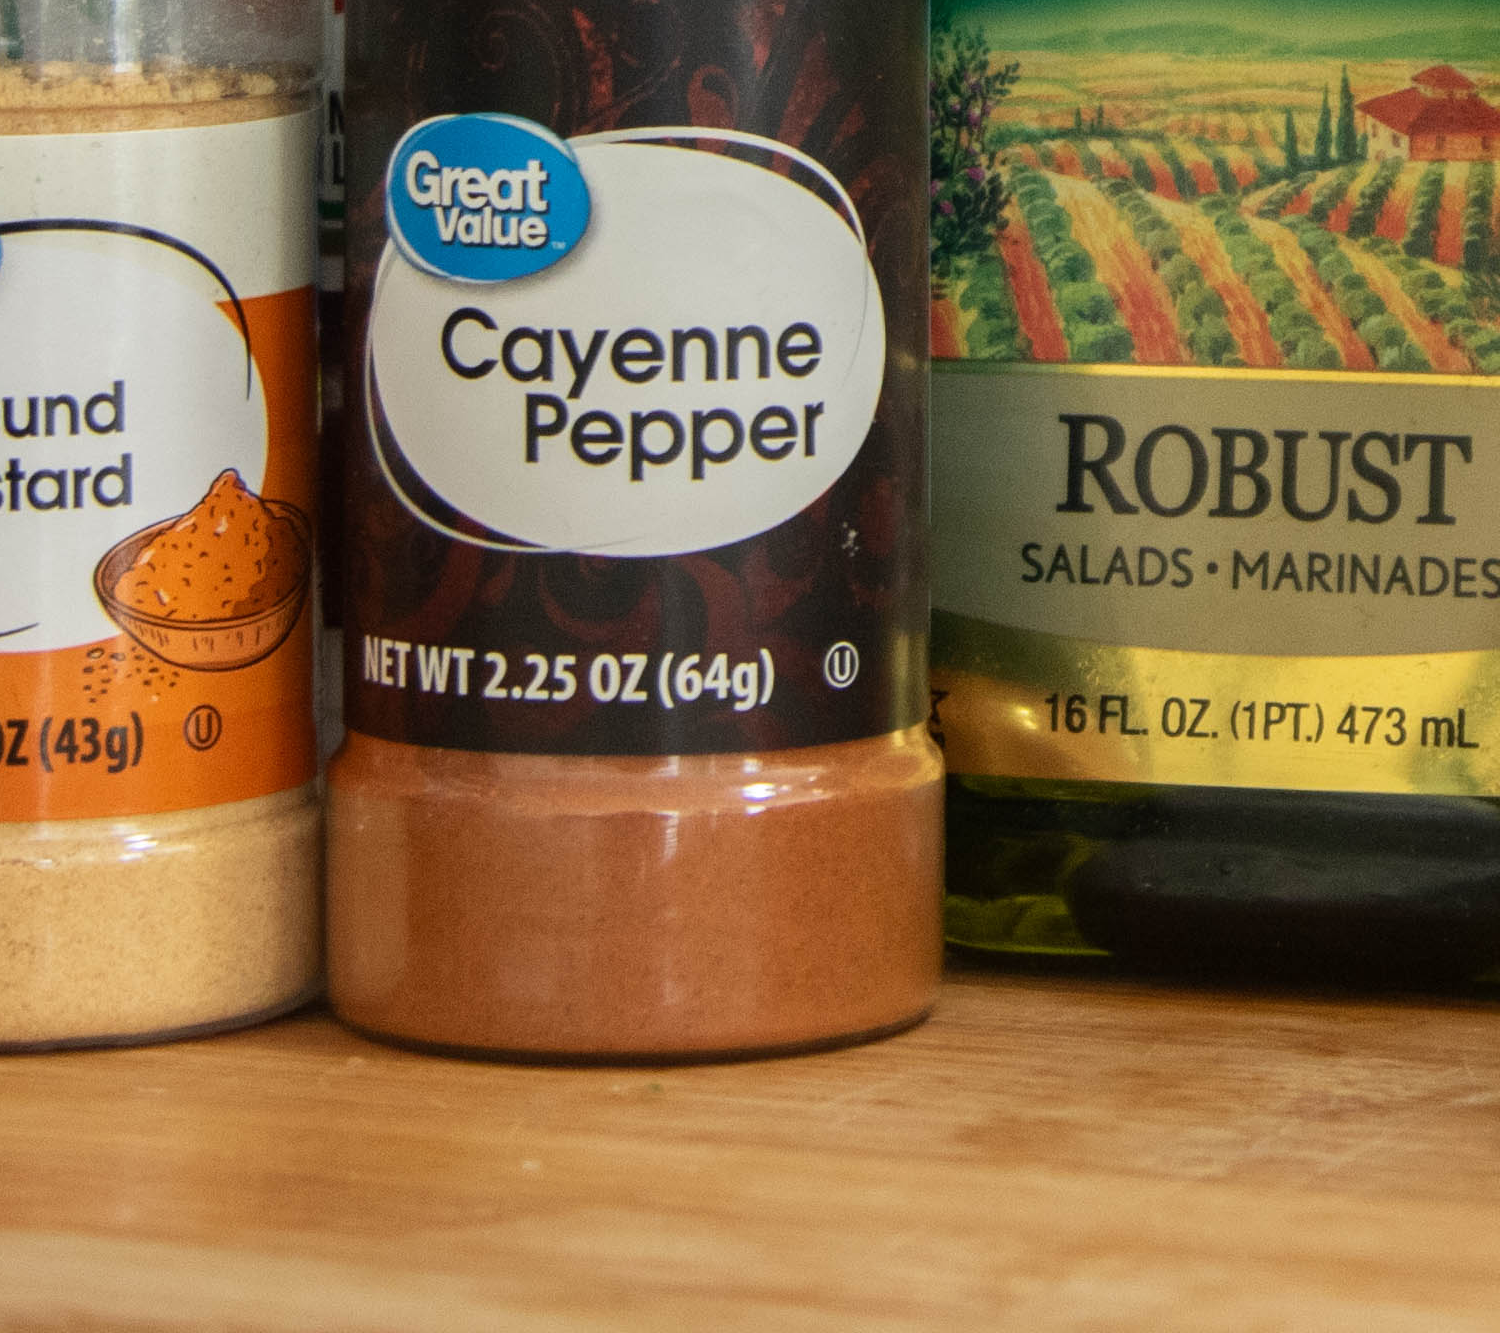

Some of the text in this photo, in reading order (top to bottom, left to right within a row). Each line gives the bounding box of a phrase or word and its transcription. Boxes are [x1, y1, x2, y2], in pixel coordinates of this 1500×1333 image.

[406, 149, 549, 213] Great
[434, 206, 548, 249] Value
[441, 306, 823, 400] Cayenne
[524, 392, 825, 482] Pepper
[1055, 412, 1474, 527] ROBUST
[1020, 541, 1194, 590] SALADS
[363, 635, 776, 712] NET WT 2.25 OZ (64g)
[39, 711, 145, 775] (43g)
[1044, 692, 1480, 751] 16 FL. OZ. (1PT.) 473 mL
